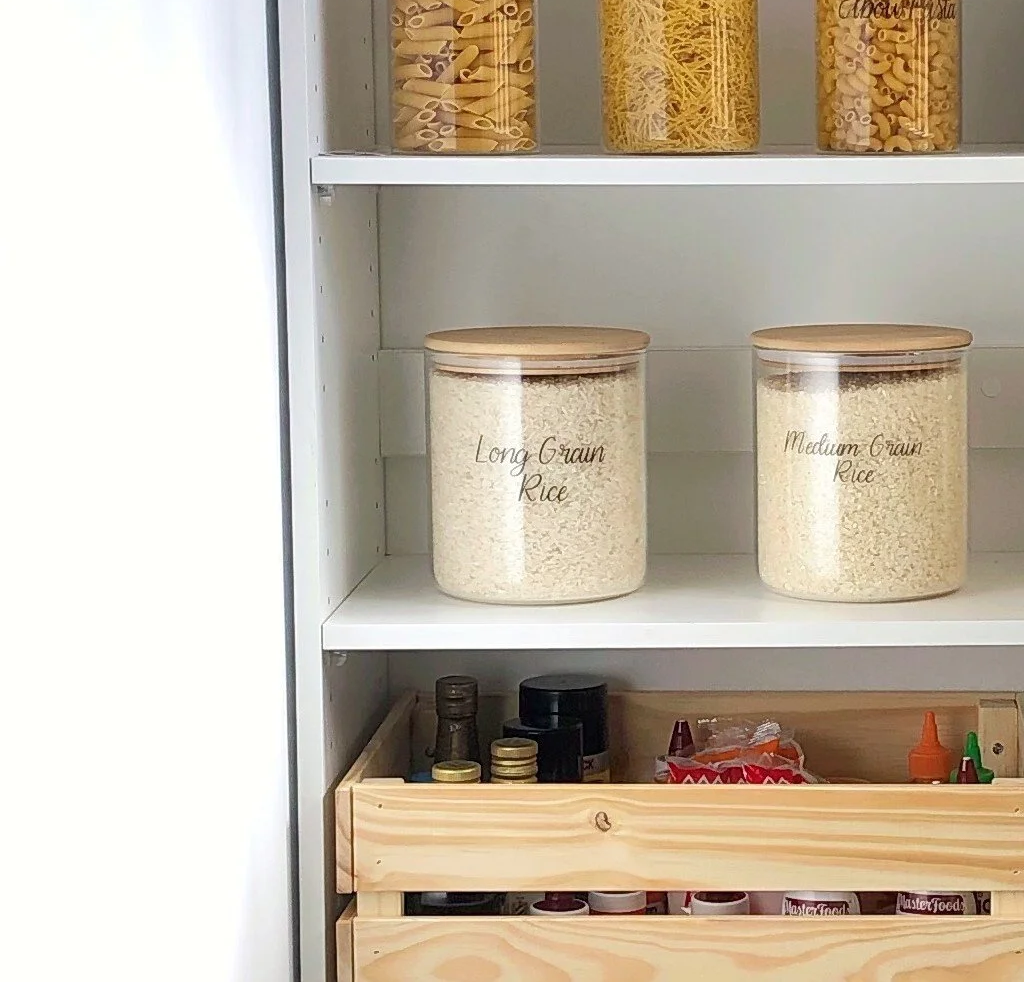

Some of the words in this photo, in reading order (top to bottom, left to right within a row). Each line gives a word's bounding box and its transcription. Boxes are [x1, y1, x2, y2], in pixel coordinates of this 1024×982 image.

[475, 434, 531, 477] Long
[538, 436, 606, 465] Grain
[784, 430, 860, 457] Medium
[869, 434, 923, 457] Grain
[833, 459, 876, 484] Rice
[518, 473, 569, 502] Rice
